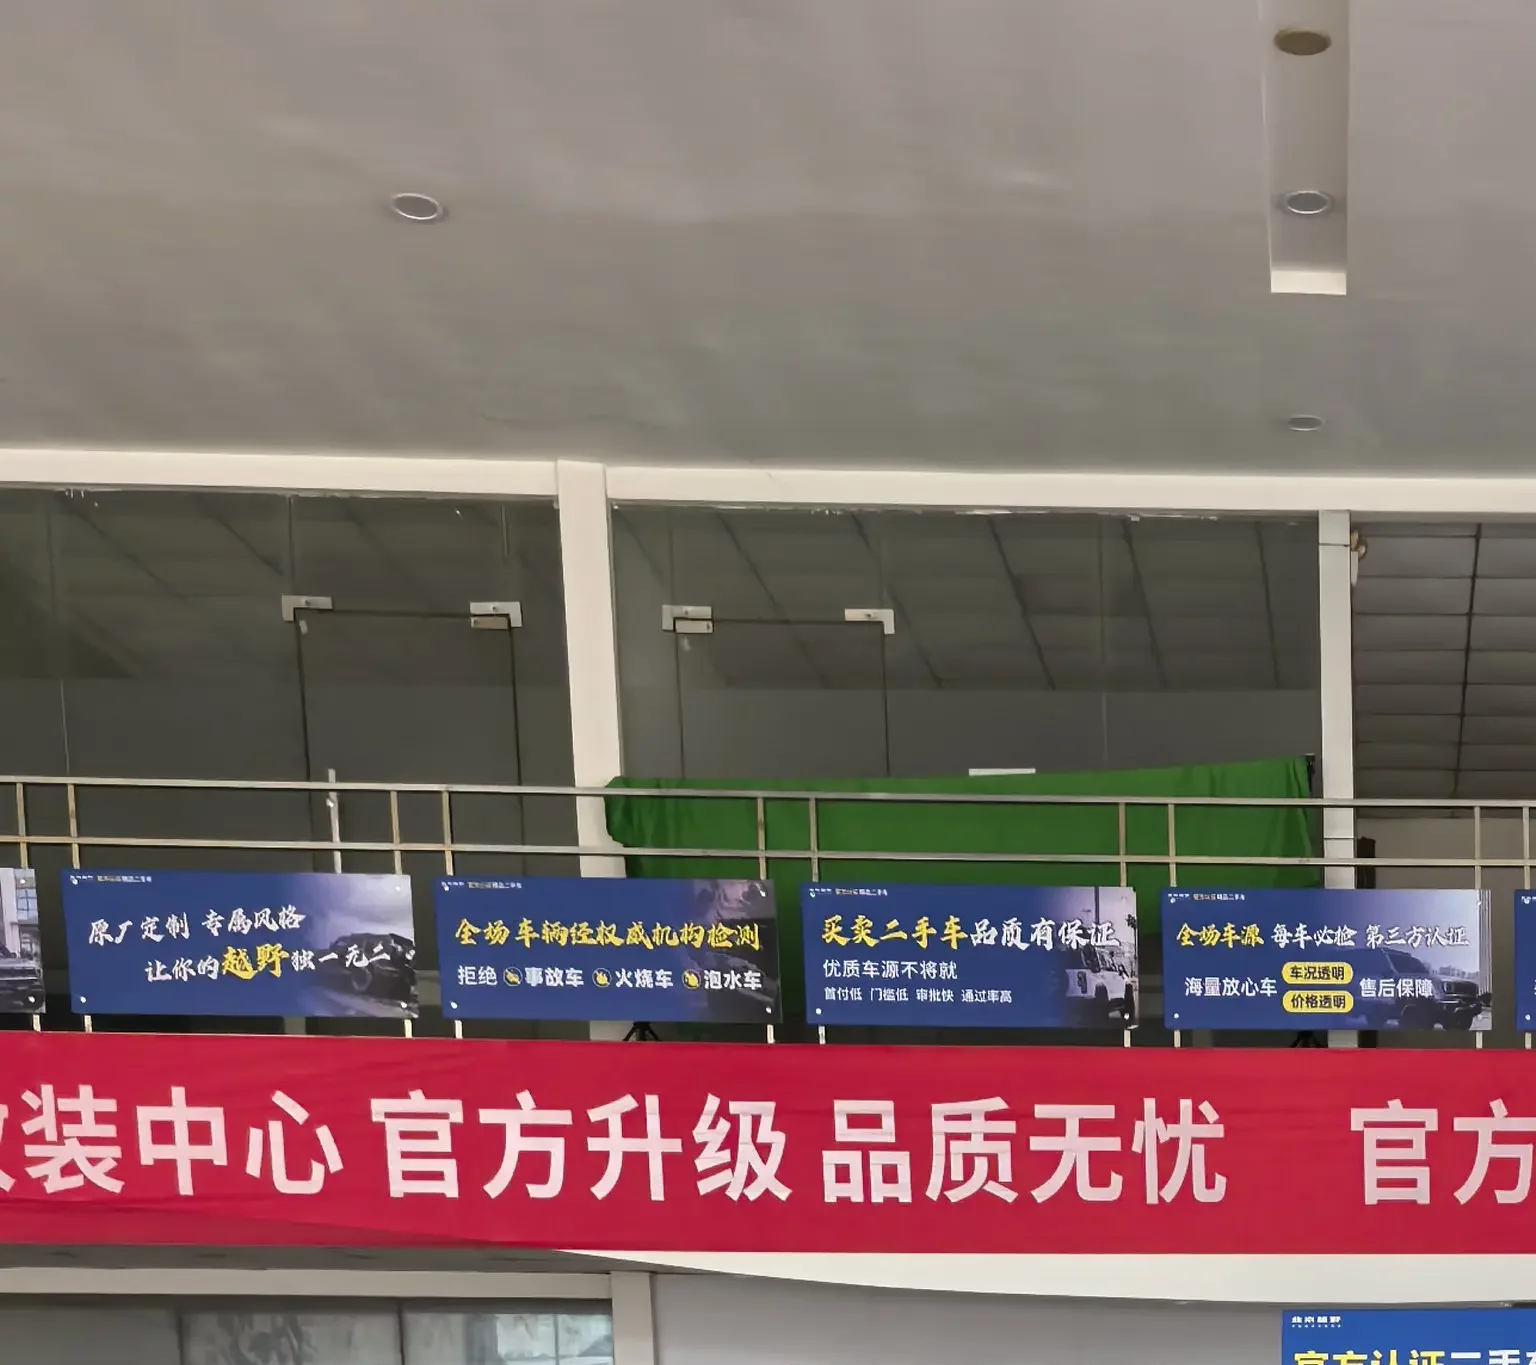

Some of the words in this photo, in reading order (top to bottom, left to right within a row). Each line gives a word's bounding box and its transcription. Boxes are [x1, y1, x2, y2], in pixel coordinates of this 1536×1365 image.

[88, 912, 190, 947] 原厂定制
[201, 904, 307, 938] 专属风格
[454, 917, 761, 952] 全场车辆经权威机构检测
[821, 913, 1122, 951] 买卖二手车品质有保证
[1176, 922, 1264, 949] 全场车源
[1271, 922, 1358, 950] 每车必检
[1365, 923, 1471, 950] 第三方认证
[144, 943, 392, 983] 让你的越野独一无二
[822, 958, 958, 980] 优质车源不将就
[1289, 965, 1346, 981] 车况透明
[457, 964, 499, 986] 拒绝
[524, 965, 585, 989] 事故车
[615, 967, 675, 989] 火烧车
[703, 969, 763, 992] 泡水车
[1184, 976, 1278, 997] 海量放心车
[1359, 978, 1434, 999] 售后保障
[823, 986, 863, 1002] 首付低
[869, 986, 909, 1003] 门槛低
[915, 988, 955, 1004] 审批快
[960, 988, 1013, 1005] 通过率高
[1290, 994, 1346, 1010] 价格透明
[0, 1084, 345, 1197] 装中心
[370, 1088, 794, 1203] 官方升级
[821, 1095, 1228, 1205] 品质无忧
